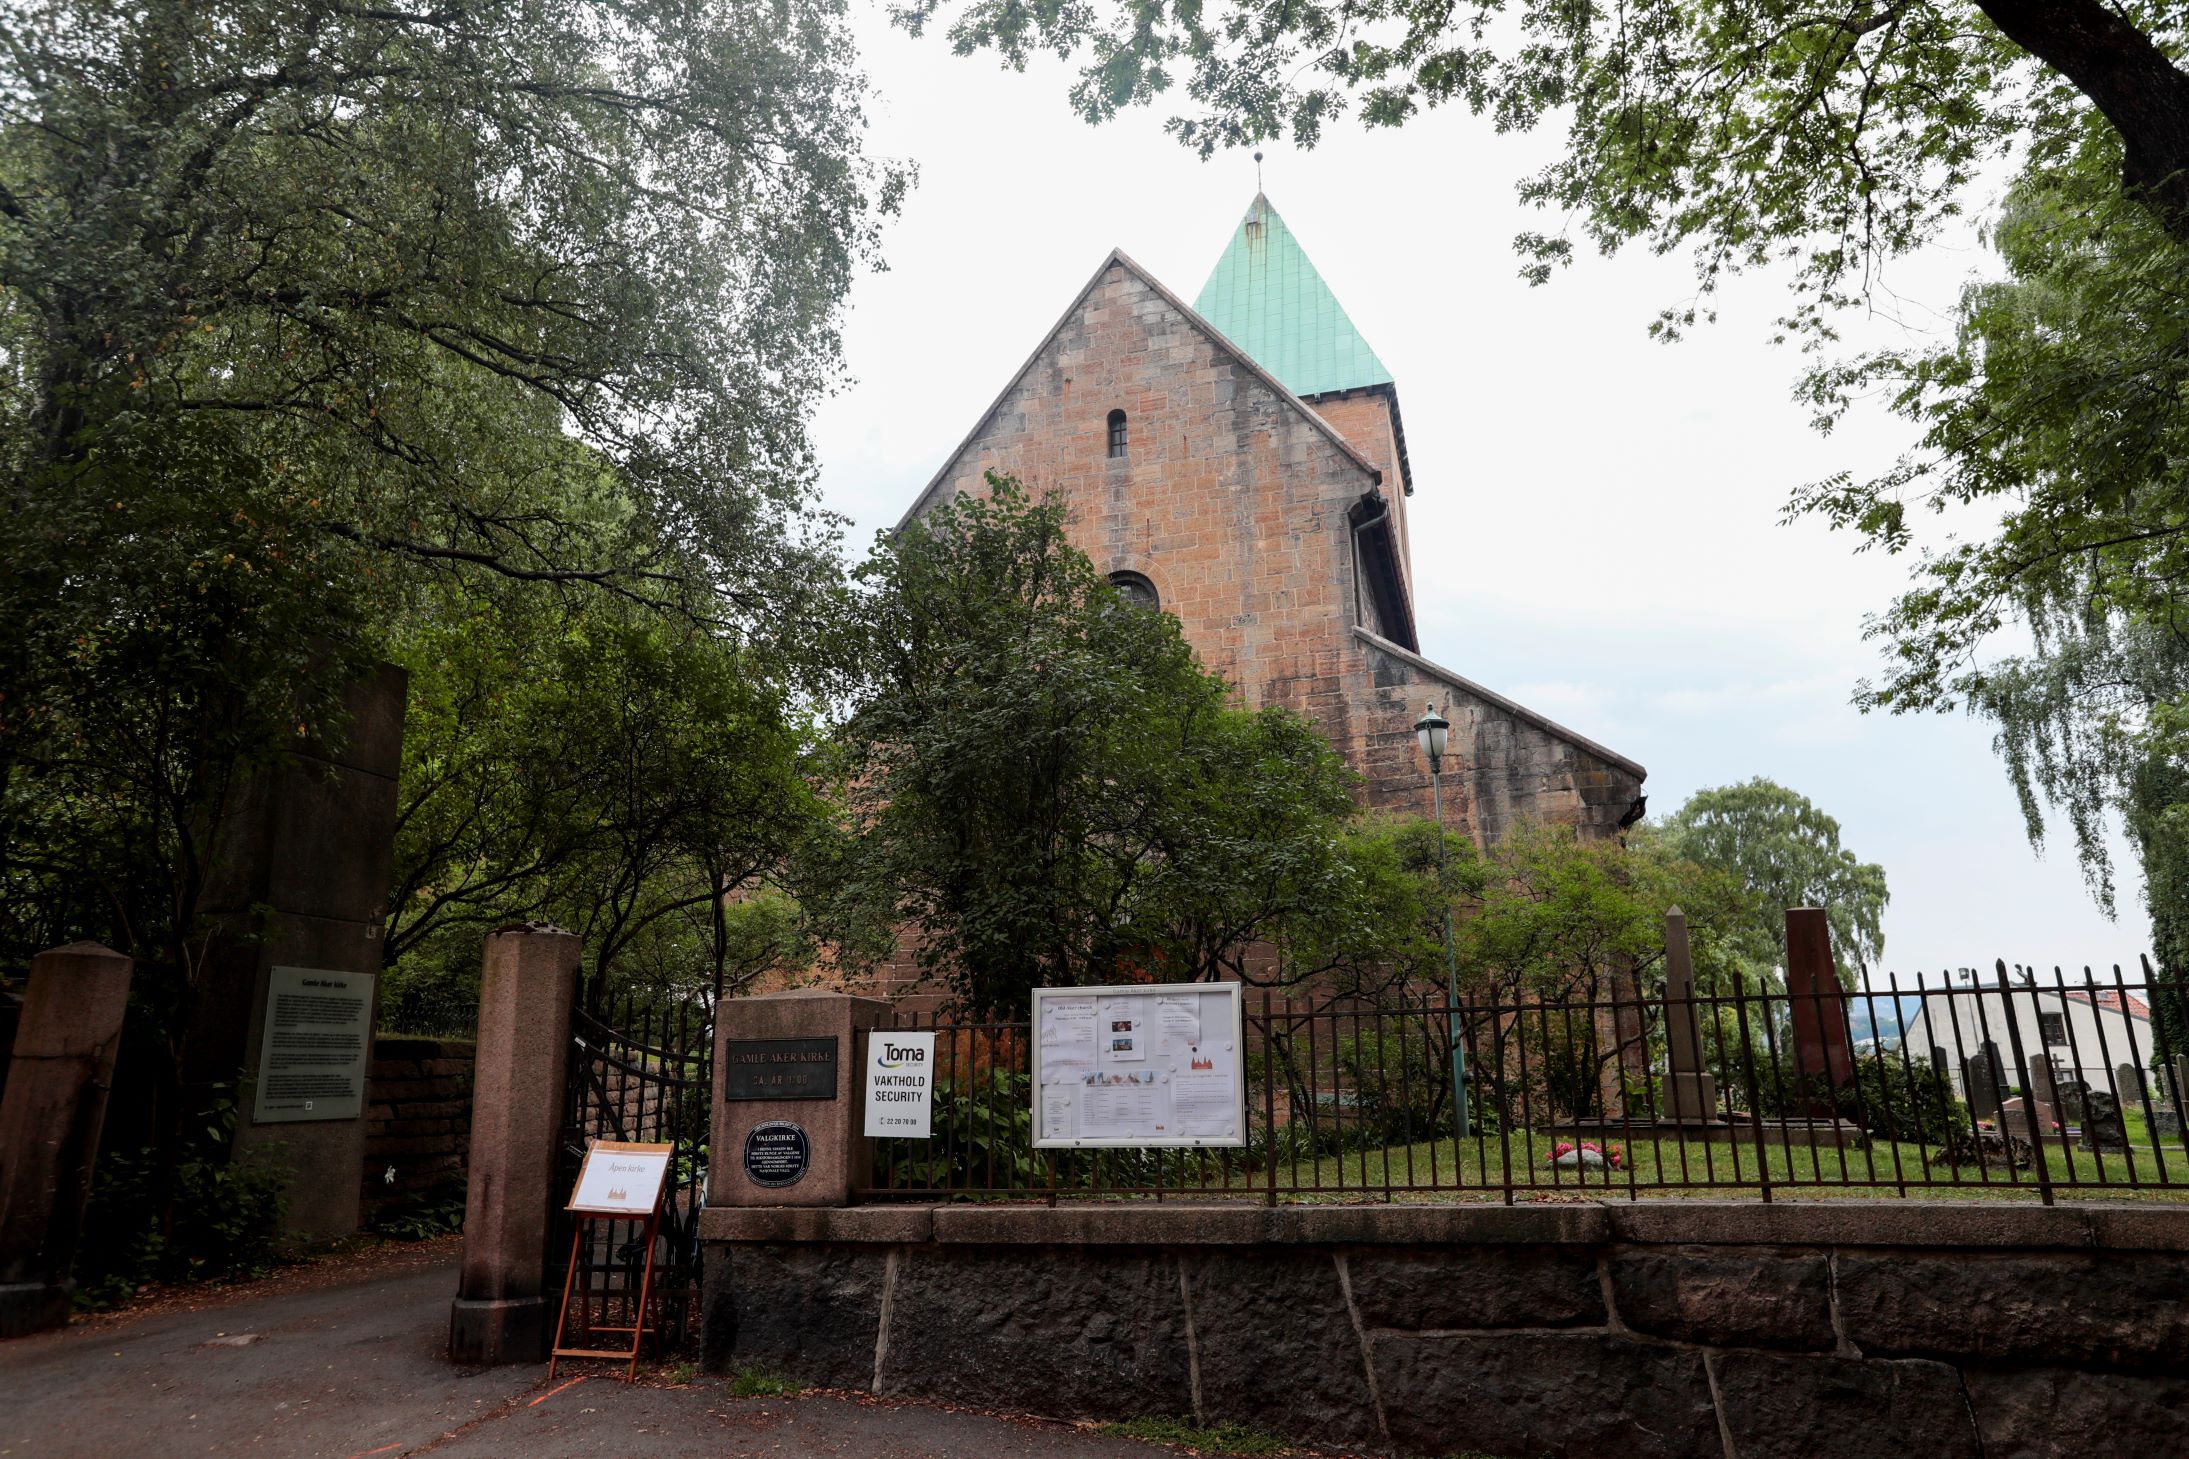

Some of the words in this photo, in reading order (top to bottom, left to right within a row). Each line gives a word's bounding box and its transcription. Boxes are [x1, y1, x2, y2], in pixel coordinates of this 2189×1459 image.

[732, 1053, 767, 1064] GAMLE
[770, 1052, 798, 1063] AKER
[800, 1051, 831, 1062] KIRKE
[884, 1043, 925, 1062] Toma
[874, 1075, 925, 1087] VAKTHOLD
[875, 1090, 923, 1102] SECURITY
[756, 1134, 796, 1142] VALGKIRKE
